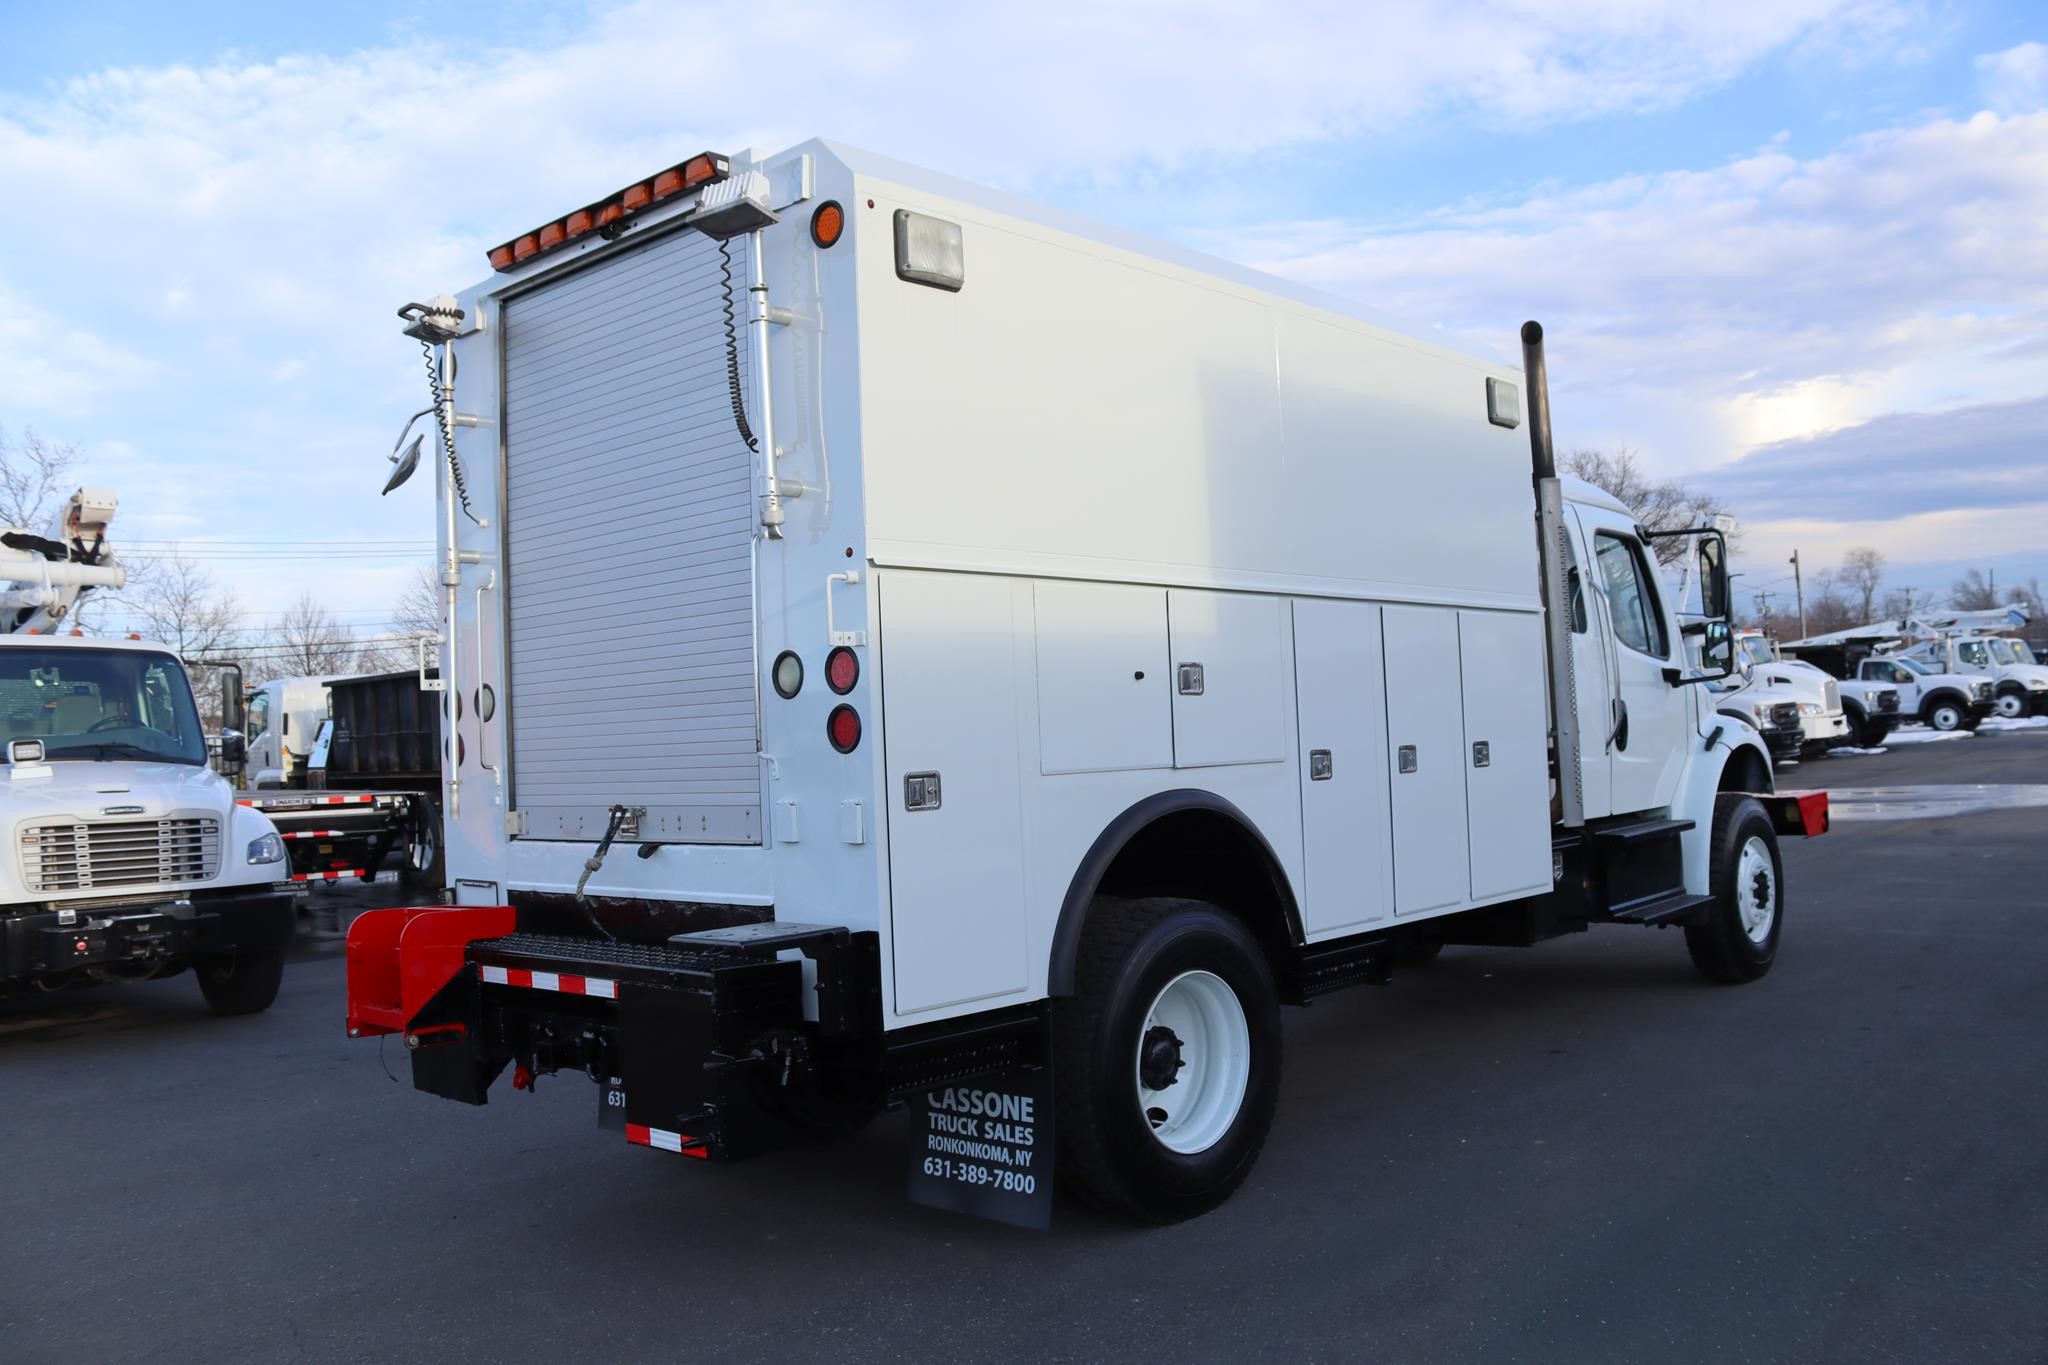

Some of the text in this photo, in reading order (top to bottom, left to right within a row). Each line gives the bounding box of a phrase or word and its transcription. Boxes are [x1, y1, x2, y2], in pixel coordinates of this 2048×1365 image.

[608, 1091, 626, 1107] 631
[928, 1112, 1034, 1145] TRUCK SALES
[928, 1134, 1032, 1167] RONKONKOMA, NY
[924, 1157, 1035, 1194] 631-389-7800
